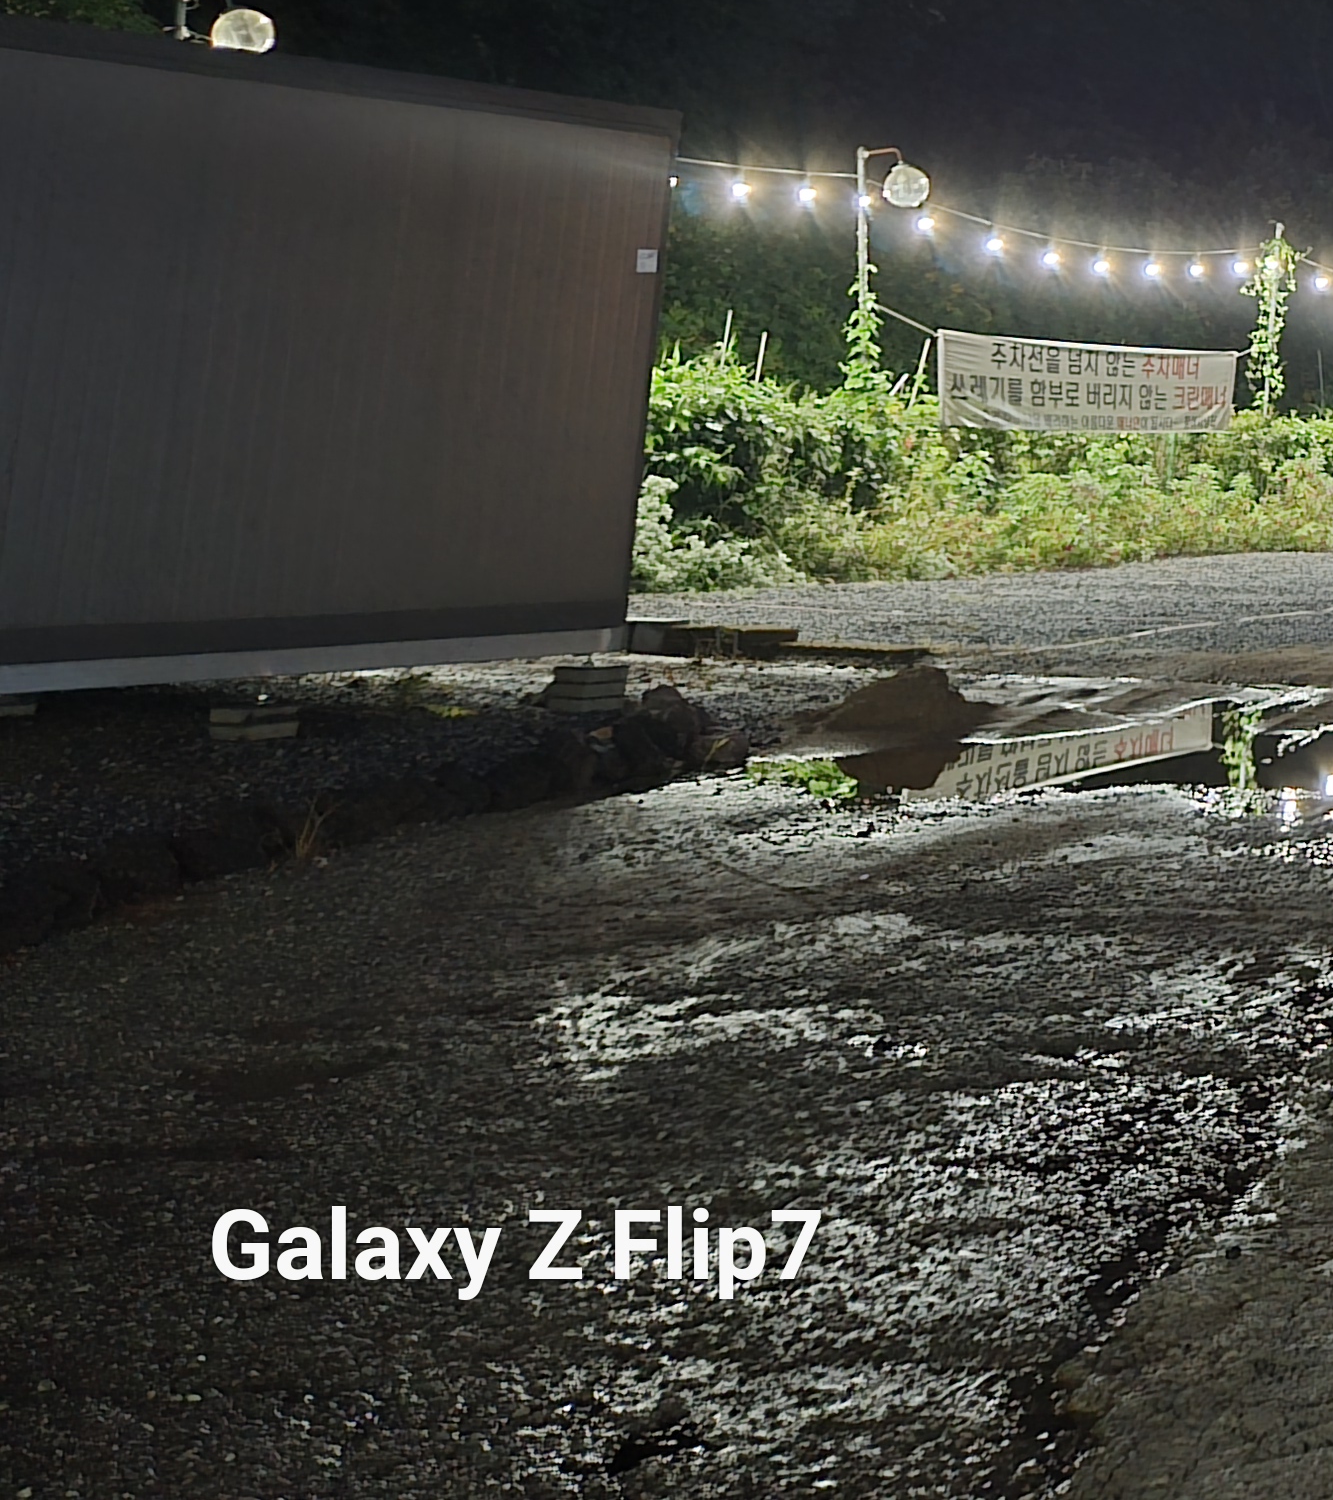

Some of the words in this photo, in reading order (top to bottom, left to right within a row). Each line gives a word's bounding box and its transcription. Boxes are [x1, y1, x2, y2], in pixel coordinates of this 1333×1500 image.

[990, 342, 1061, 374] 주차선을
[1068, 348, 1099, 376] 넘지
[1105, 351, 1135, 378] 않는
[1142, 354, 1200, 380] 주차매너
[950, 373, 1023, 407] 쓰레기를
[1030, 378, 1080, 409] 함부로
[1086, 382, 1132, 410] 버리지
[1139, 384, 1167, 411] 않는
